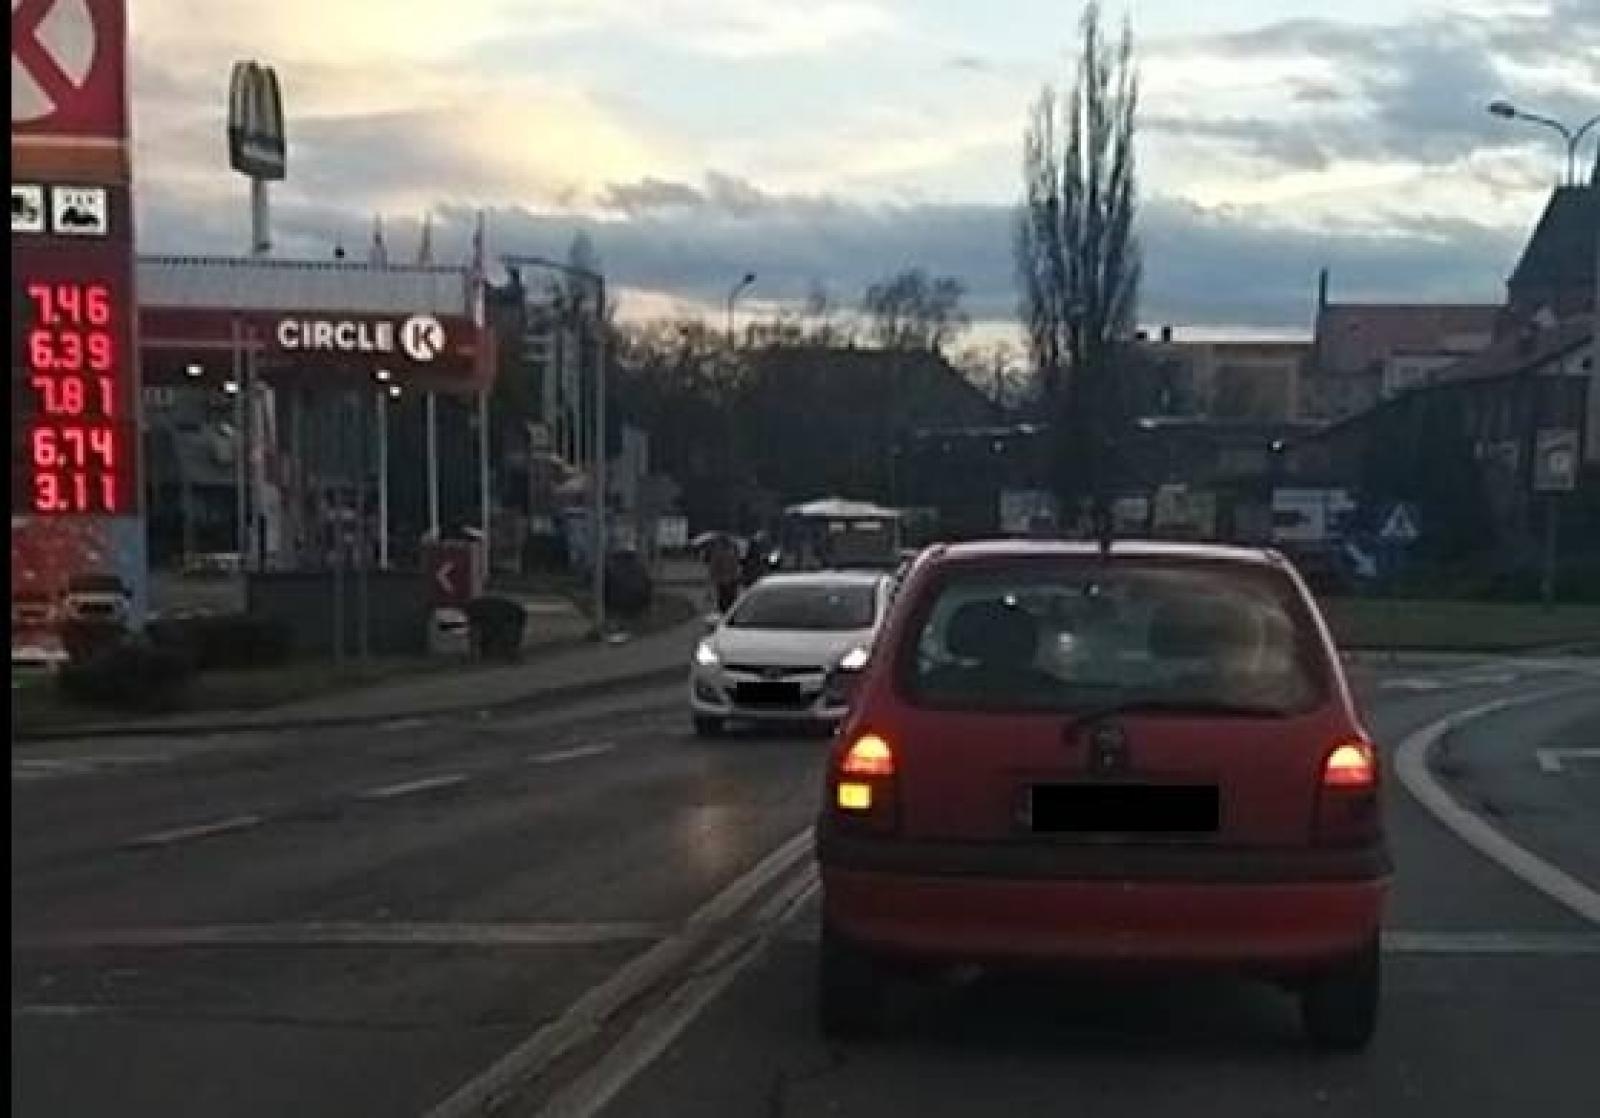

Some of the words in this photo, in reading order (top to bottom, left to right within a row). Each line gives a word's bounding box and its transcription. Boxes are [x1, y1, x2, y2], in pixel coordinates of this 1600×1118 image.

[28, 285, 110, 324] 7.46
[30, 332, 111, 369] 6.39
[278, 320, 395, 351] CIRCLE
[403, 315, 445, 361] K
[32, 376, 113, 416] 7.81
[34, 427, 113, 467] 6.74
[36, 472, 115, 511] 3.11
